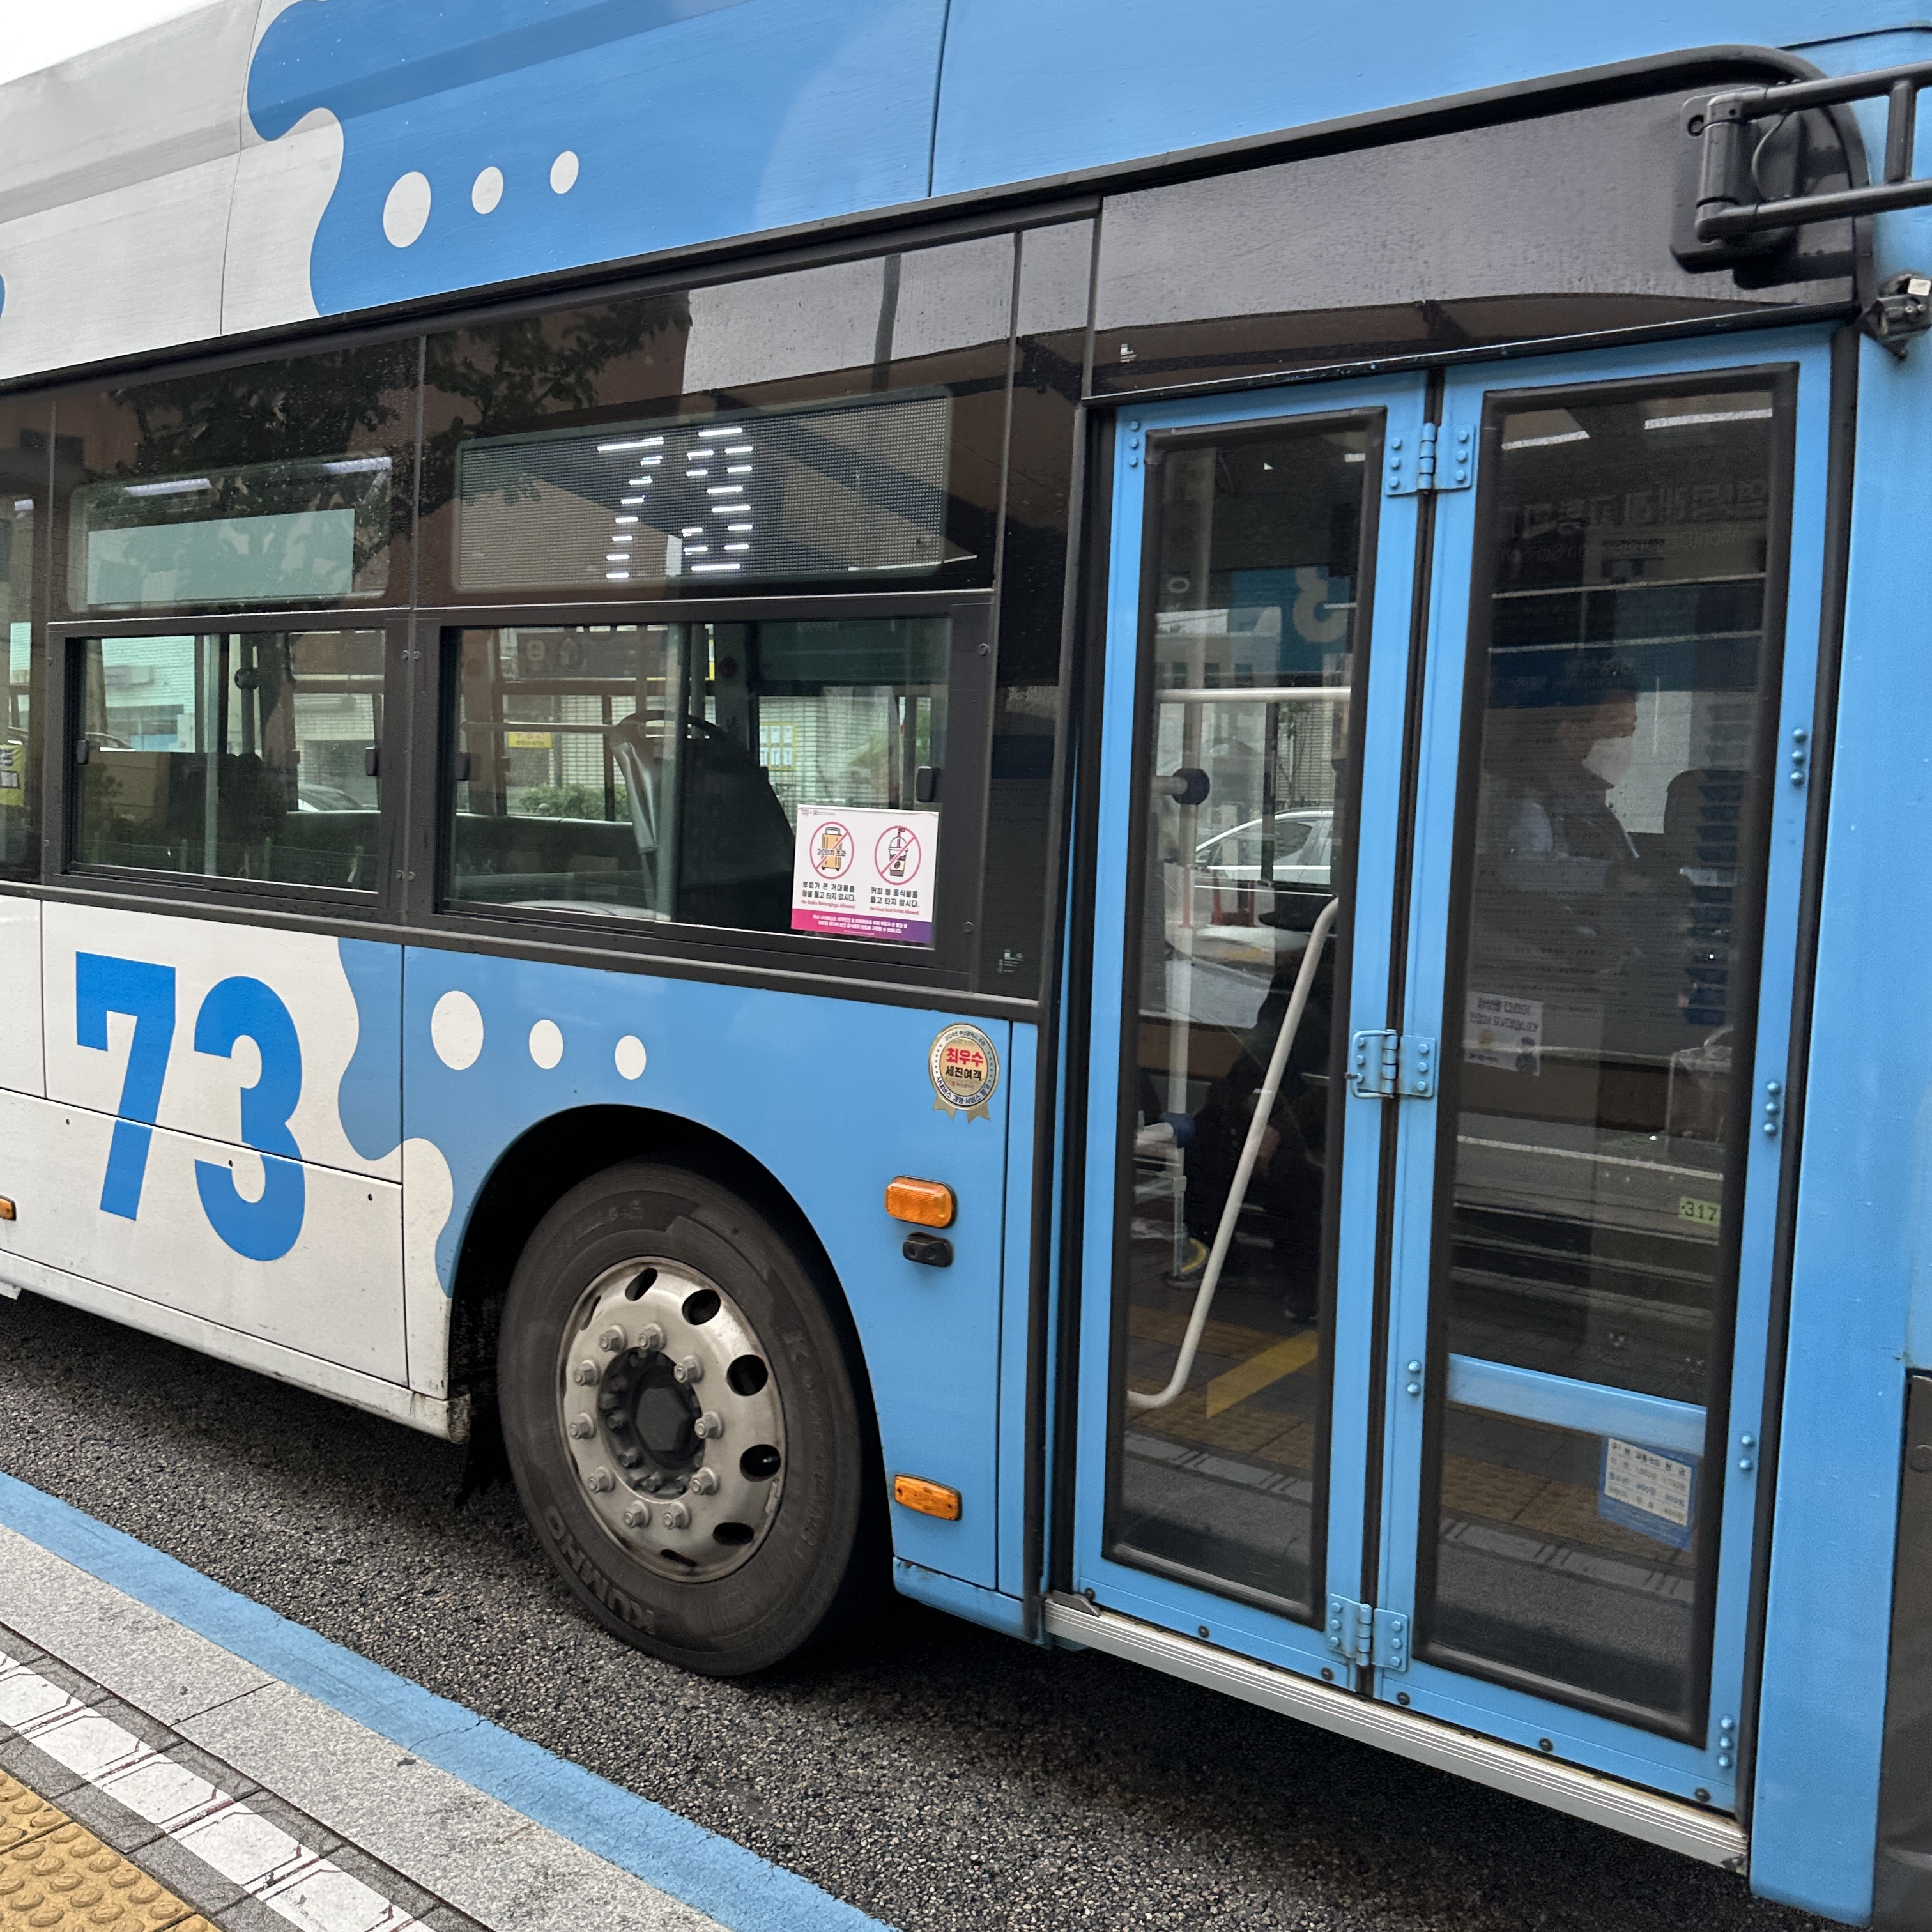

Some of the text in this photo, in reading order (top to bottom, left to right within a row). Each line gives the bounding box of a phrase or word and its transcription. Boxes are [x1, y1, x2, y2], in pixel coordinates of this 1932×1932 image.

[802, 881, 820, 889] 부피가
[871, 887, 883, 895] 커피
[893, 889, 918, 898] 음식물을
[871, 896, 882, 904] 들고
[946, 1047, 983, 1067] 최우수
[946, 1066, 982, 1081] 세진여객
[76, 951, 305, 1261] 73
